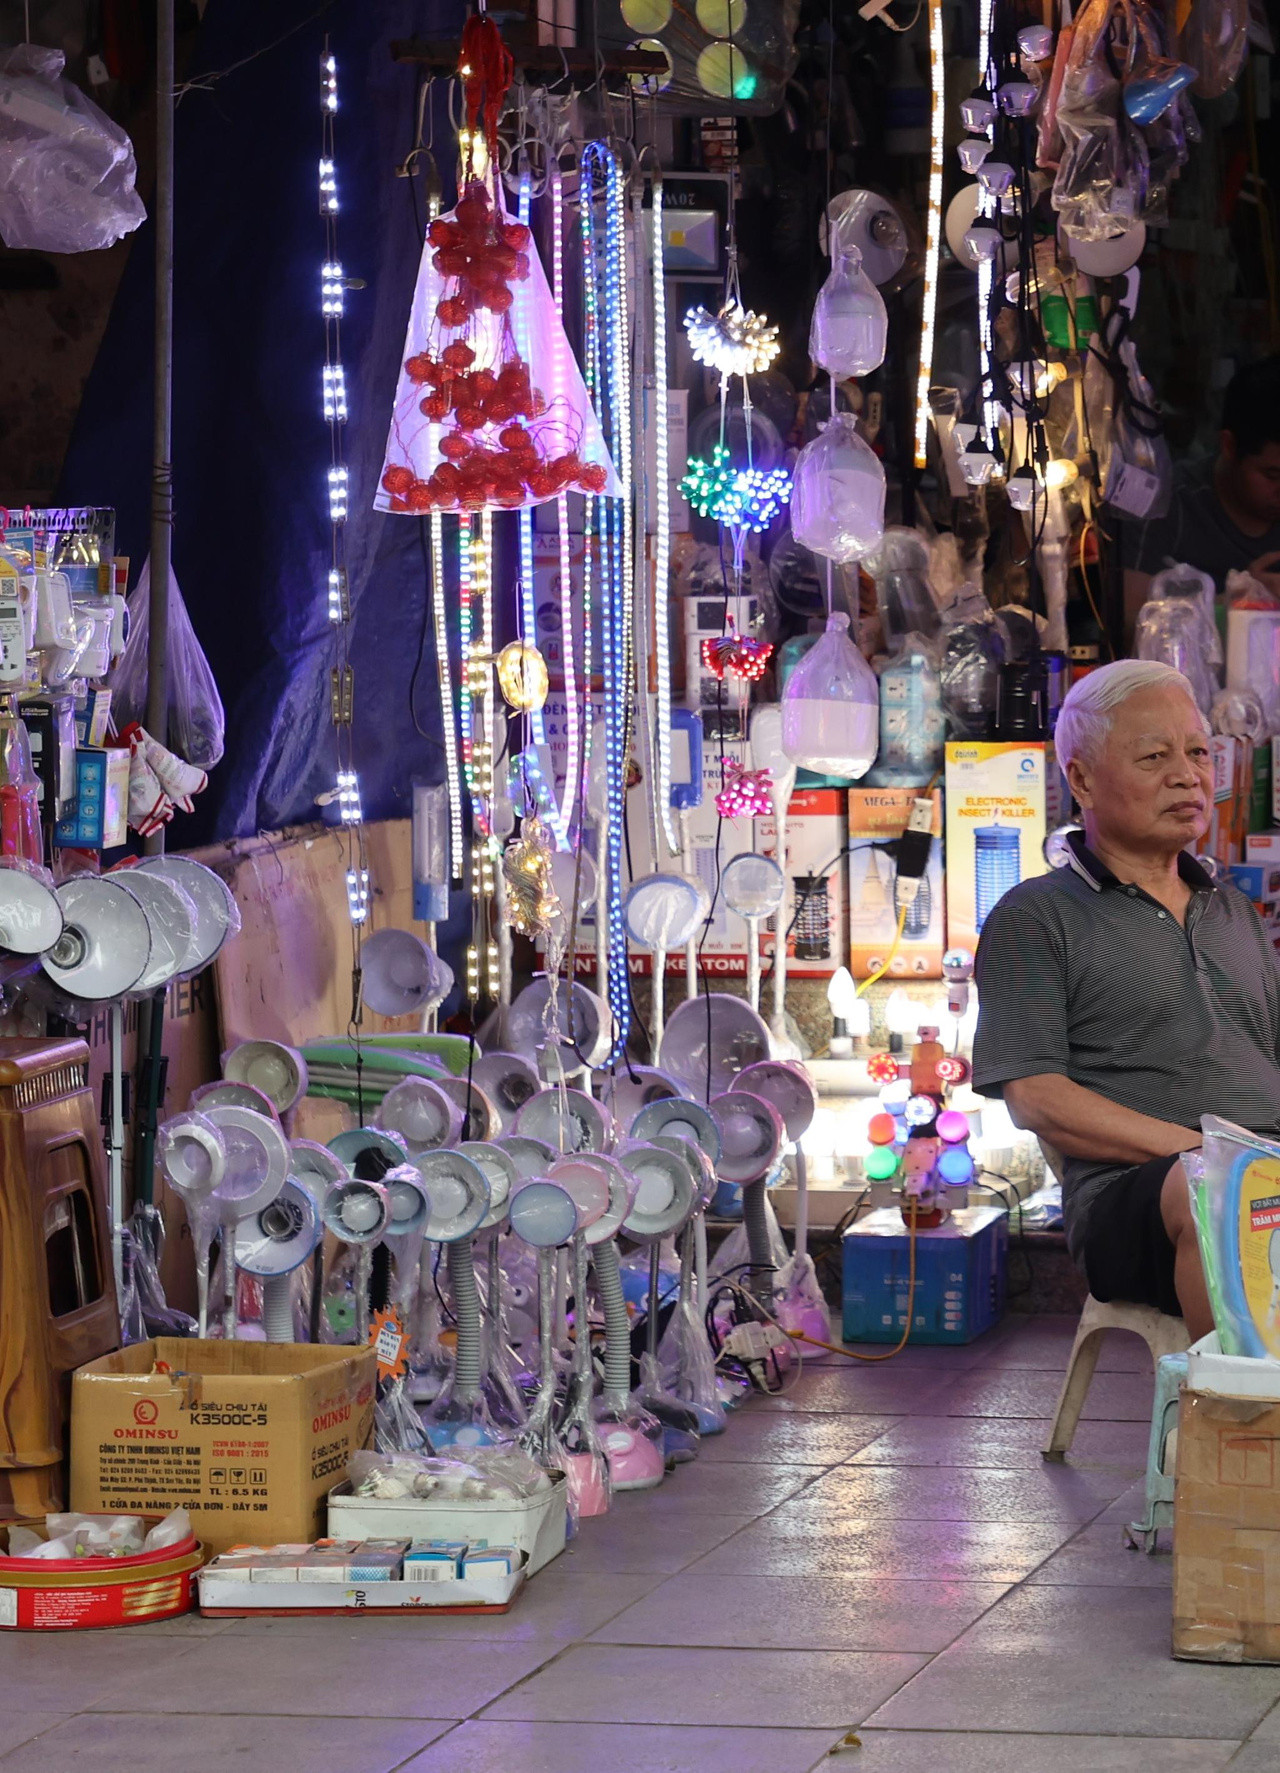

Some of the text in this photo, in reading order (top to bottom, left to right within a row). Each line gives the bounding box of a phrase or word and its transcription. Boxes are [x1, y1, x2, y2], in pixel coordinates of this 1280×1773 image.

[965, 797, 1027, 806] ELECTRONIC
[958, 809, 1036, 817] INSECT KILLER
[201, 1402, 222, 1411] SIÊU
[226, 1403, 247, 1413] CHỊU
[190, 1413, 267, 1426] K3500C-5
[312, 1404, 351, 1433] OMINSU
[113, 1428, 179, 1440] OMINSU
[99, 1443, 200, 1456] CÔNG TY TNHH OMINSU VIỆT NAM
[212, 1449, 225, 1457] ISO
[251, 1450, 269, 1458] 2015
[209, 1488, 221, 1496] TL
[232, 1488, 249, 1496] 6.5
[252, 1488, 268, 1496] KG
[102, 1500, 106, 1508] 1
[110, 1498, 127, 1508] CỬA
[182, 1499, 201, 1510] CỬA
[253, 1503, 268, 1511] 5M
